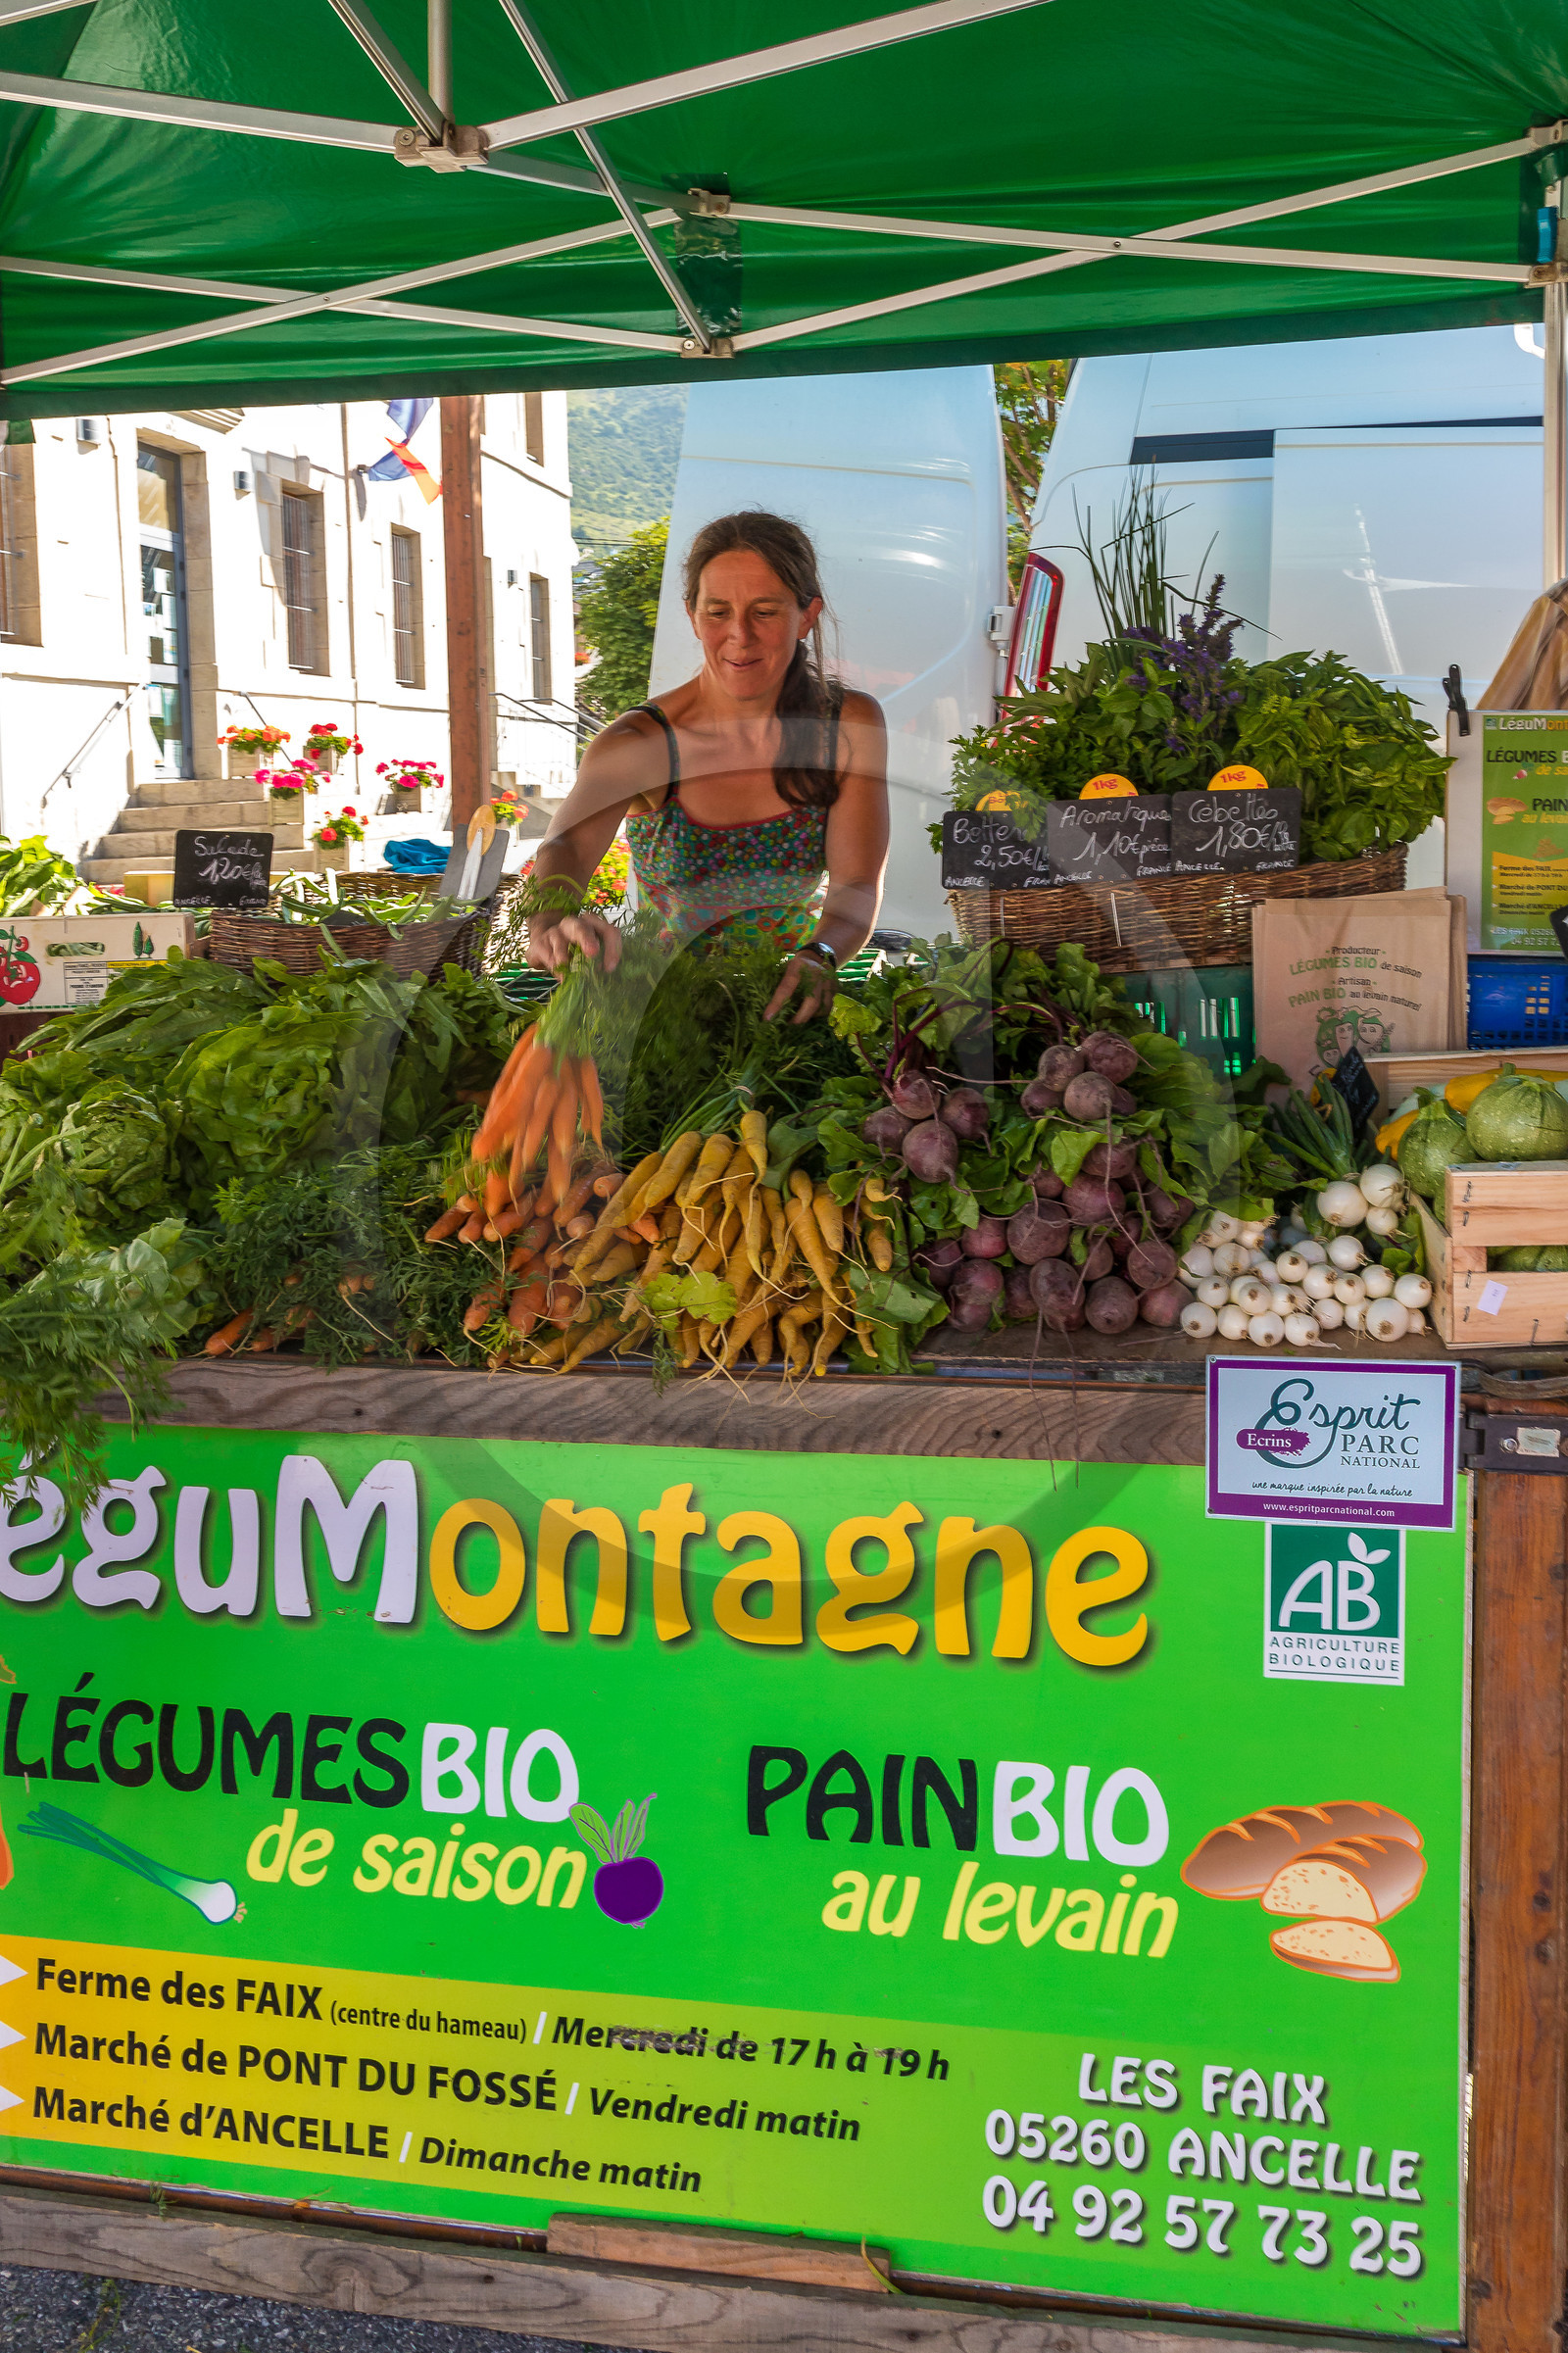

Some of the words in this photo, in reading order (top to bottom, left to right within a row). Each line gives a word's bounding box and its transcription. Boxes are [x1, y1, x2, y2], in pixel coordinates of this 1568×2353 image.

[1487, 747, 1557, 762] LÉGUMES
[1093, 778, 1118, 790] 1kg
[1221, 770, 1247, 783] 1kg
[195, 836, 265, 857] Salade
[1332, 946, 1381, 956] Producteur
[1290, 956, 1350, 975] LÉGUMES
[1353, 957, 1377, 969] BIO
[1394, 964, 1423, 979] saison
[1338, 977, 1371, 986] Artisan
[1289, 989, 1320, 1007] PAIN
[1324, 988, 1347, 1001] BIO
[1253, 1378, 1421, 1469] Esprit
[1247, 1433, 1292, 1448] Ecrins
[1341, 1434, 1420, 1455] PARC
[1341, 1455, 1420, 1469] NATIONAL
[1251, 1480, 1268, 1490] une
[1269, 1482, 1304, 1494] marque
[1307, 1483, 1345, 1495] inspirée
[1348, 1487, 1365, 1496] par
[1367, 1484, 1378, 1495] la
[1380, 1487, 1413, 1497] nature
[1263, 1502, 1396, 1518] www.espritparcnational.com
[1278, 1560, 1382, 1632] AB
[1269, 1636, 1401, 1656] AGRICULTURE
[1268, 1651, 1400, 1673] BIOLOGIQUE
[2, 1672, 411, 1809] LÉGUMES
[420, 1722, 580, 1823] BIO
[747, 1744, 979, 1852] PAIN
[993, 1760, 1170, 1867] BIO
[246, 1808, 335, 1887] de
[353, 1823, 588, 1910] saison
[821, 1870, 921, 1937] au
[943, 1862, 1179, 1958] levain
[36, 1957, 151, 2002] Ferme
[161, 1969, 225, 2011] des
[235, 1981, 323, 2021] FAIX
[330, 1999, 402, 2031] (centre
[406, 2004, 431, 2034] du
[436, 2009, 527, 2045] hameau)
[552, 2016, 708, 2059] Mercredi
[716, 2030, 759, 2063] de
[846, 2041, 867, 2074] à
[35, 2023, 172, 2072] Marché
[180, 2032, 227, 2077] de
[237, 2044, 347, 2088] PONT
[358, 2058, 416, 2098] DU
[428, 2065, 558, 2112] FOSSÉ
[589, 2086, 748, 2130] Vendredi
[755, 2109, 860, 2141] matin
[1079, 2053, 1179, 2110] LES
[1201, 2065, 1328, 2125] FAIX
[32, 2085, 170, 2133] Marché
[419, 2136, 592, 2183] Dimanche
[598, 2160, 702, 2194] matin
[985, 2109, 1147, 2170] 05260
[1168, 2128, 1423, 2202] ANCELLE
[983, 2175, 1054, 2233] 04
[1072, 2184, 1144, 2244] 92
[1164, 2194, 1239, 2255] 57
[1257, 2205, 1329, 2266] 73
[1350, 2217, 1423, 2278] 25
